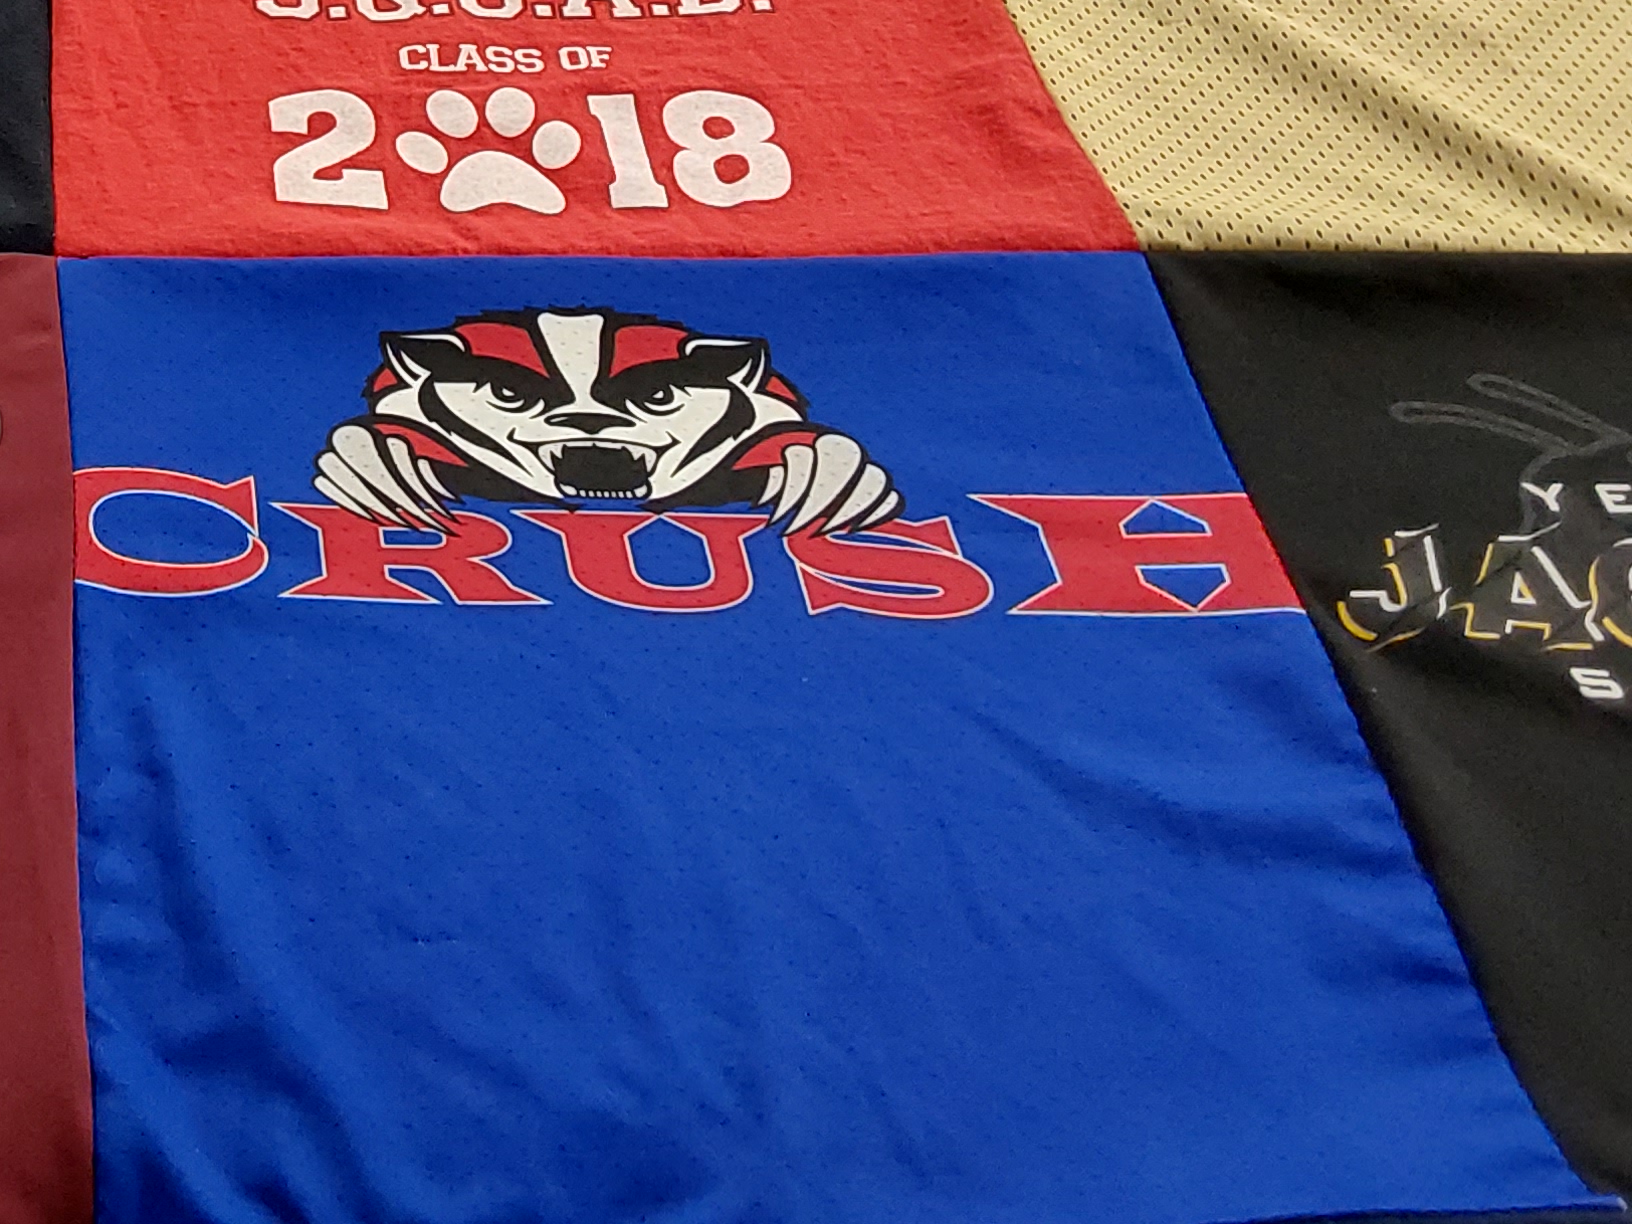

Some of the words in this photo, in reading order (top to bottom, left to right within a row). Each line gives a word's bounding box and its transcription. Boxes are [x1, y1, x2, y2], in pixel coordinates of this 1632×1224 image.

[398, 43, 545, 74] CLASS
[558, 45, 613, 71] OF
[72, 466, 1308, 620] CRUSH
